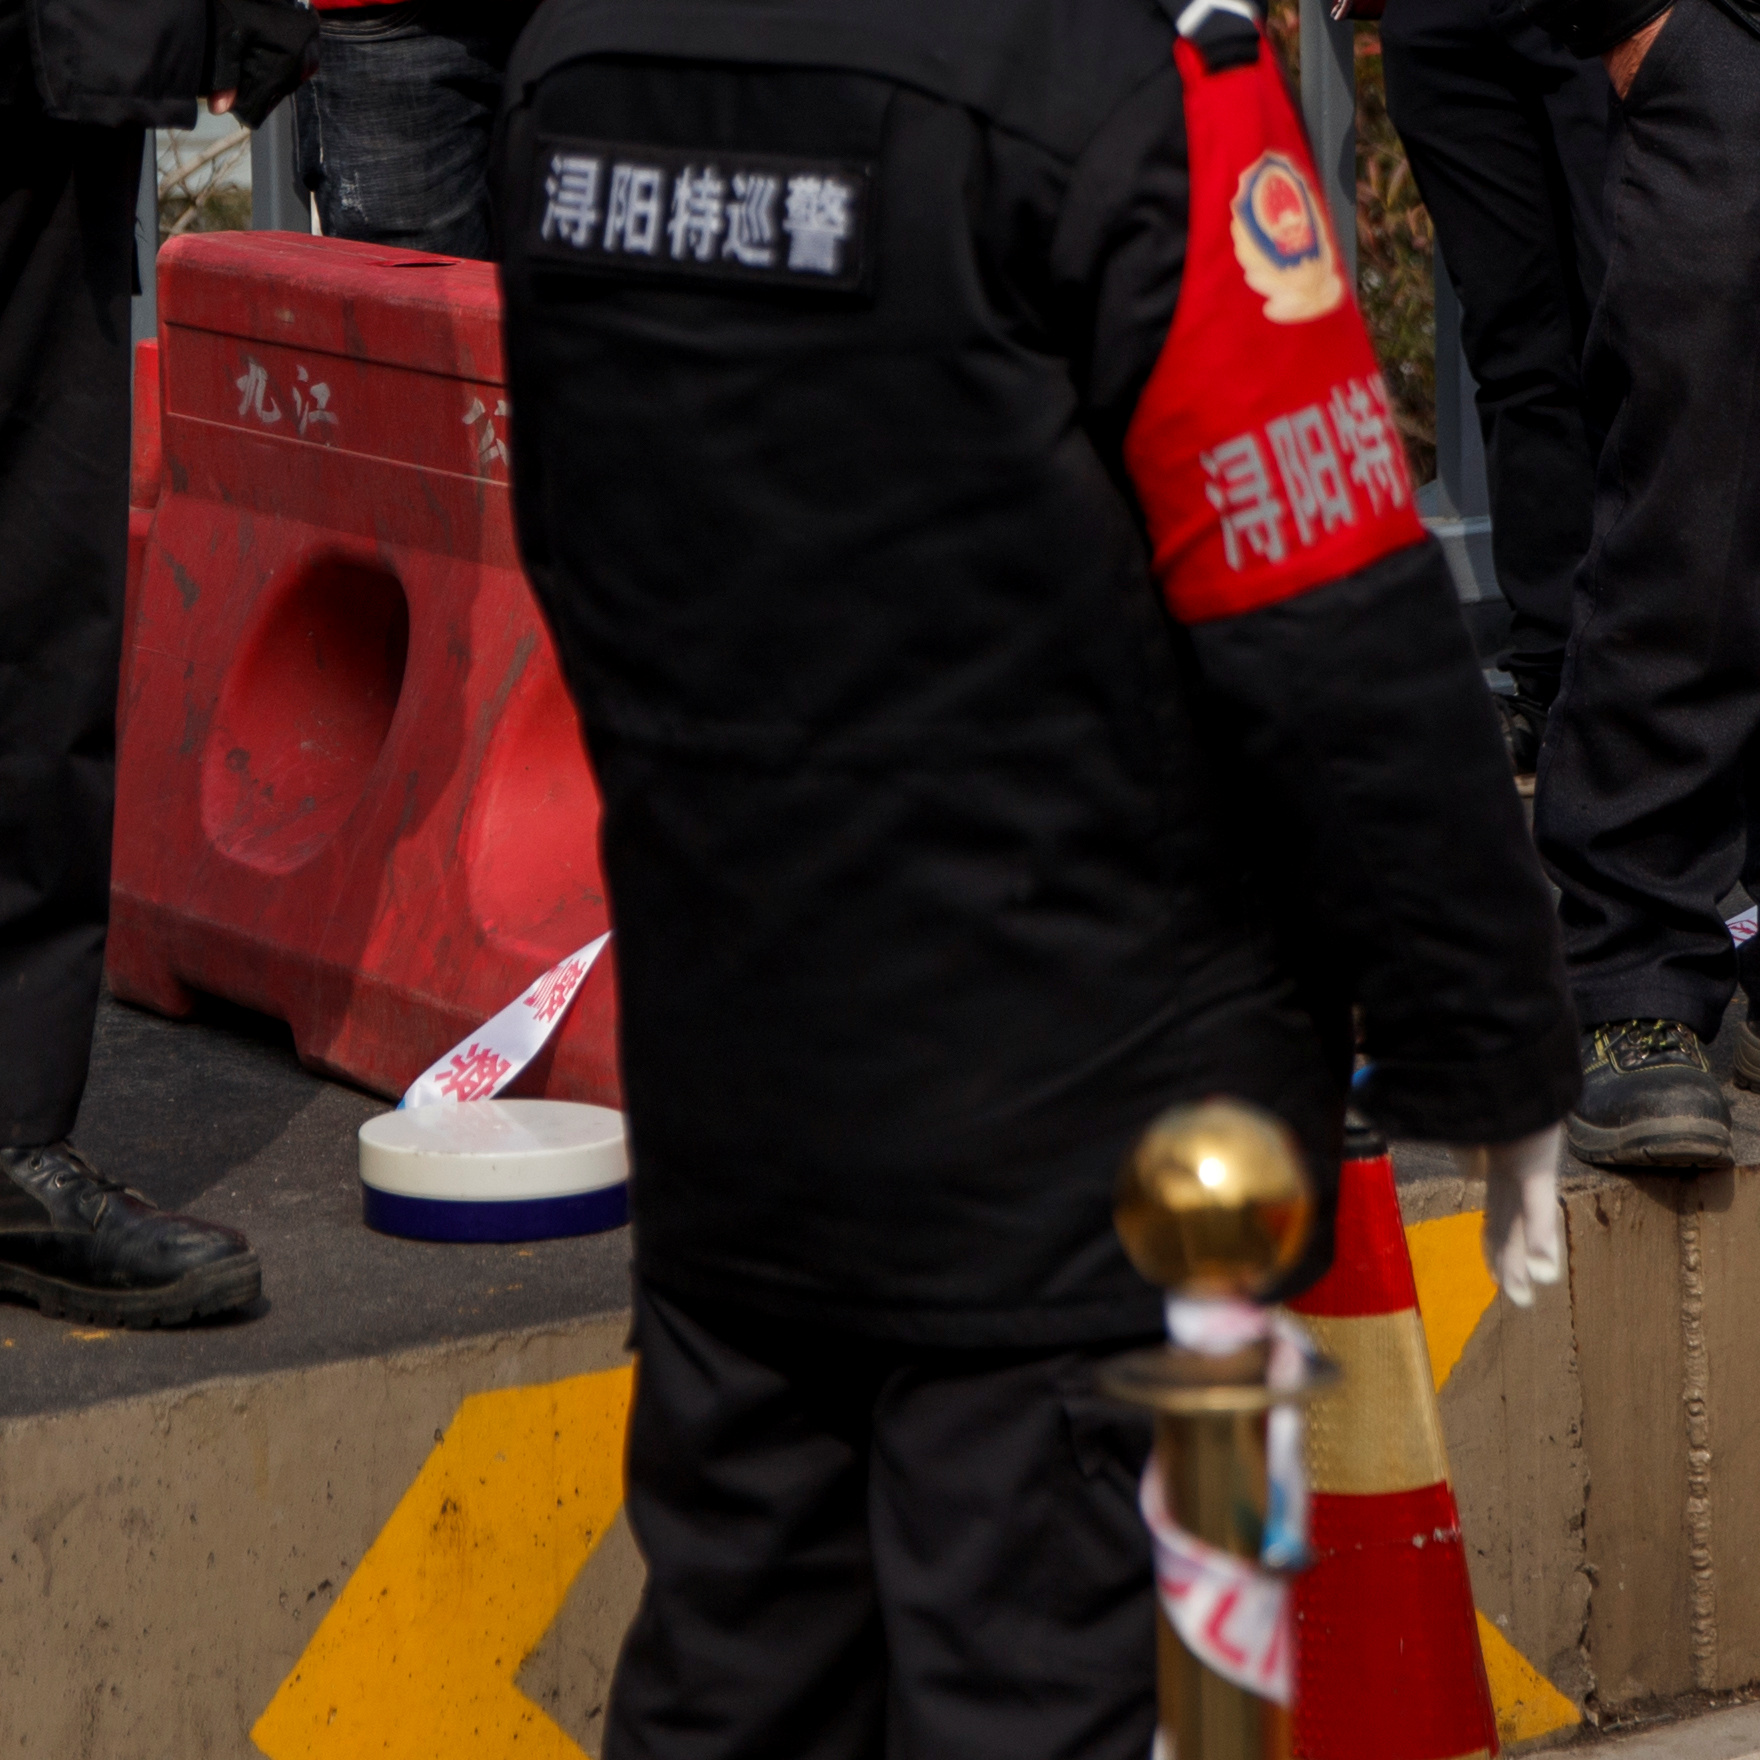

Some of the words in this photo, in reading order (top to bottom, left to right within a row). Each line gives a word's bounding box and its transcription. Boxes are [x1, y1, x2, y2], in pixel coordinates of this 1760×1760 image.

[541, 152, 854, 276] 浔阳特巡警
[236, 356, 339, 436] 九江
[1199, 372, 1410, 573] 浔阳特
